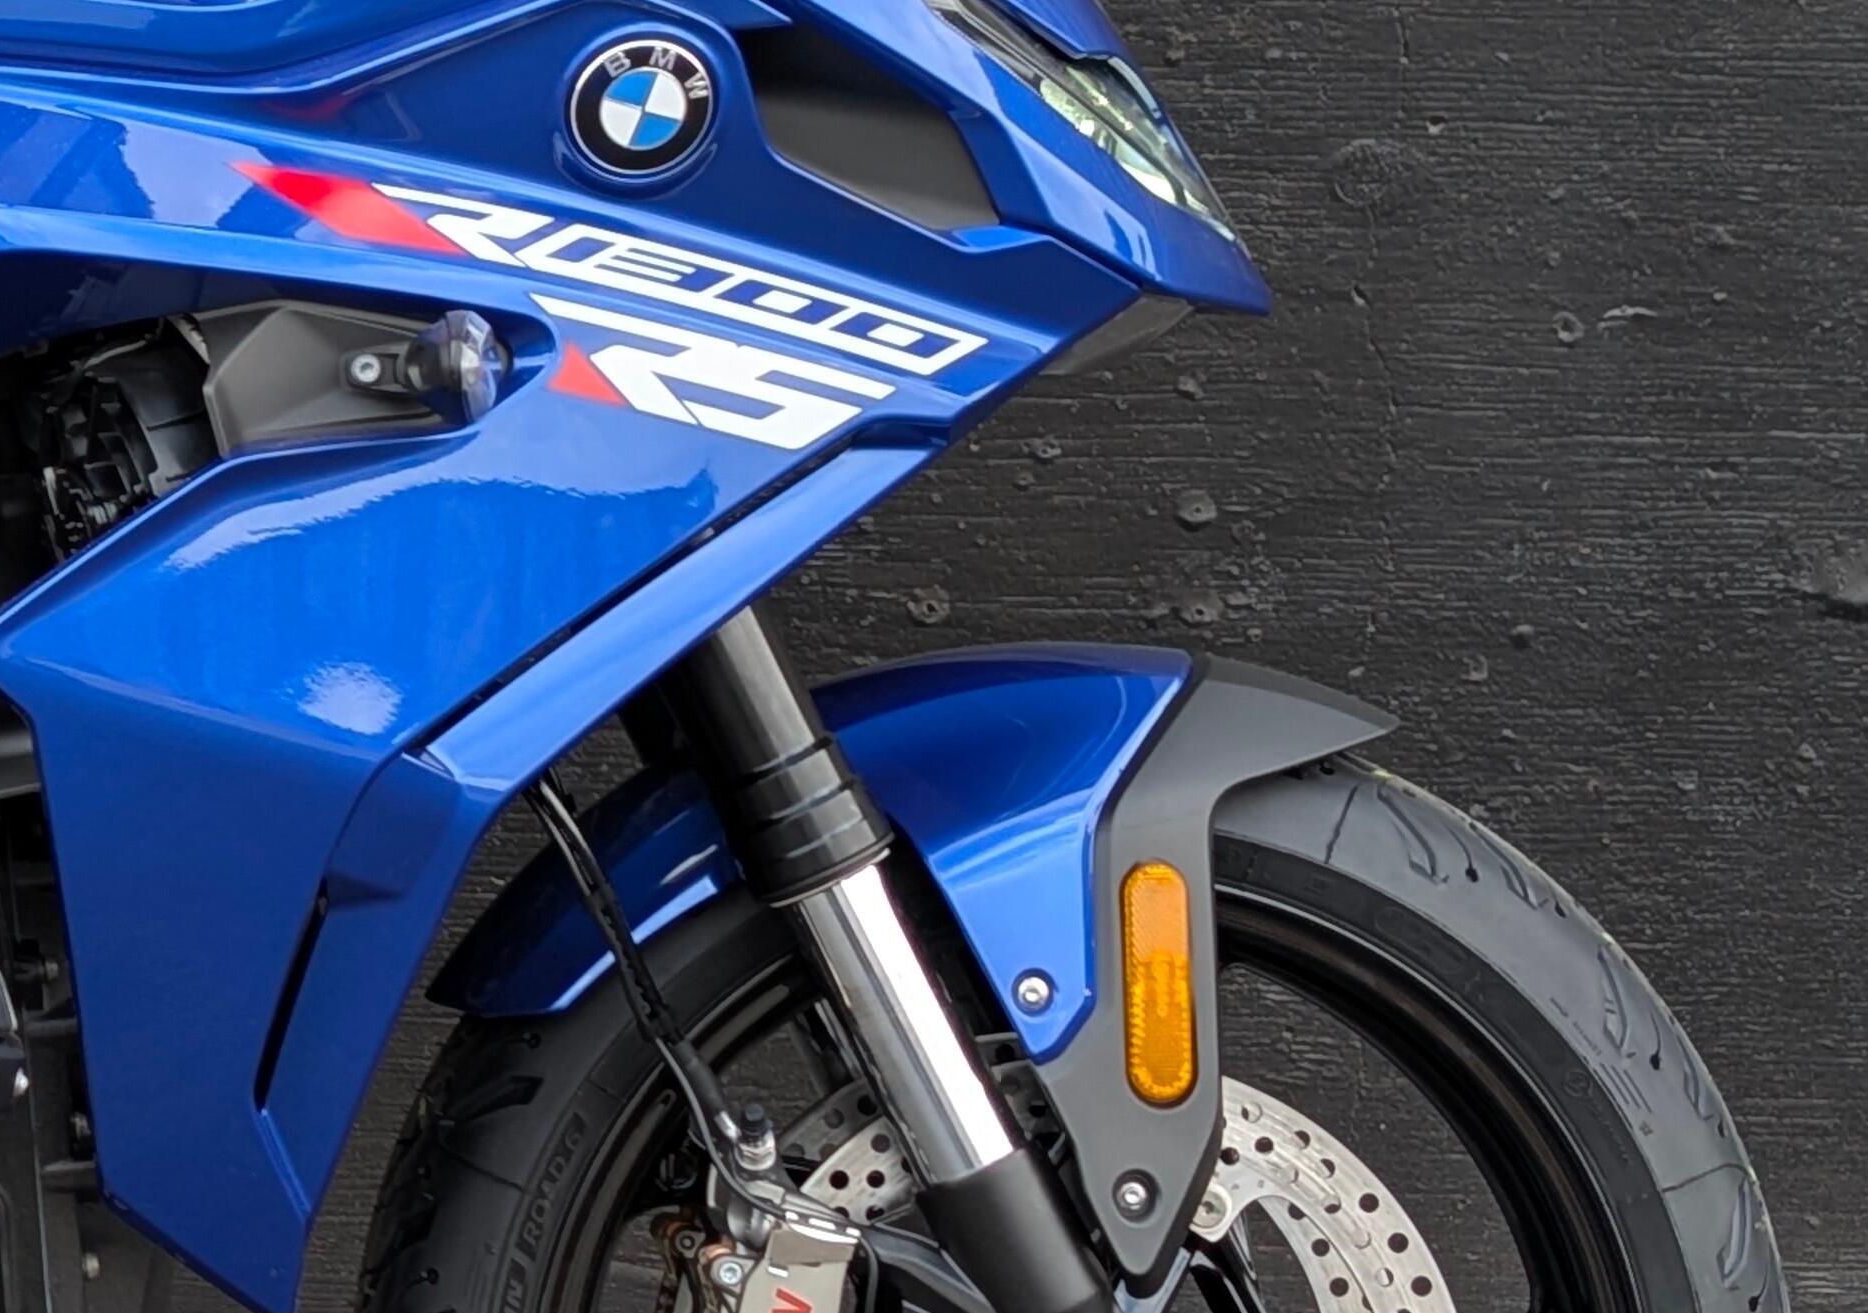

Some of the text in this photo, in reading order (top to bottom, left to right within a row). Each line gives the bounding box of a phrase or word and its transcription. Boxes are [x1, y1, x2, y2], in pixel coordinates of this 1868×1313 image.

[602, 46, 709, 100] BMW
[529, 292, 896, 450] RS
[523, 1154, 568, 1248] ROAD
